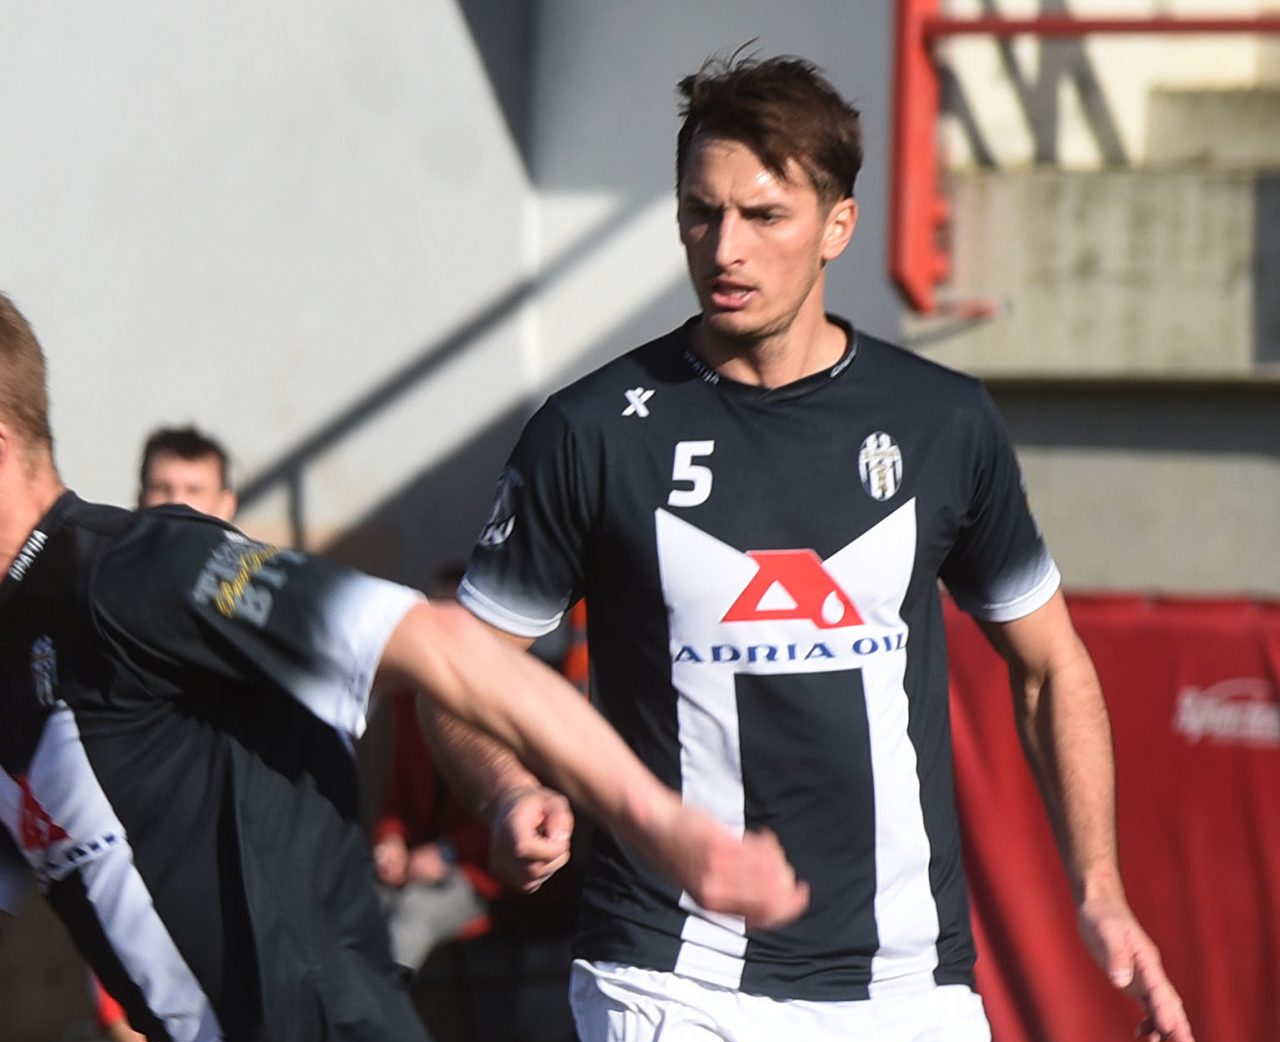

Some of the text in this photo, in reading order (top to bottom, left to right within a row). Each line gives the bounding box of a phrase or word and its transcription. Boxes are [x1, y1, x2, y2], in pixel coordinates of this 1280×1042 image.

[668, 440, 715, 508] 5
[673, 631, 907, 664] ADRIA OIL
